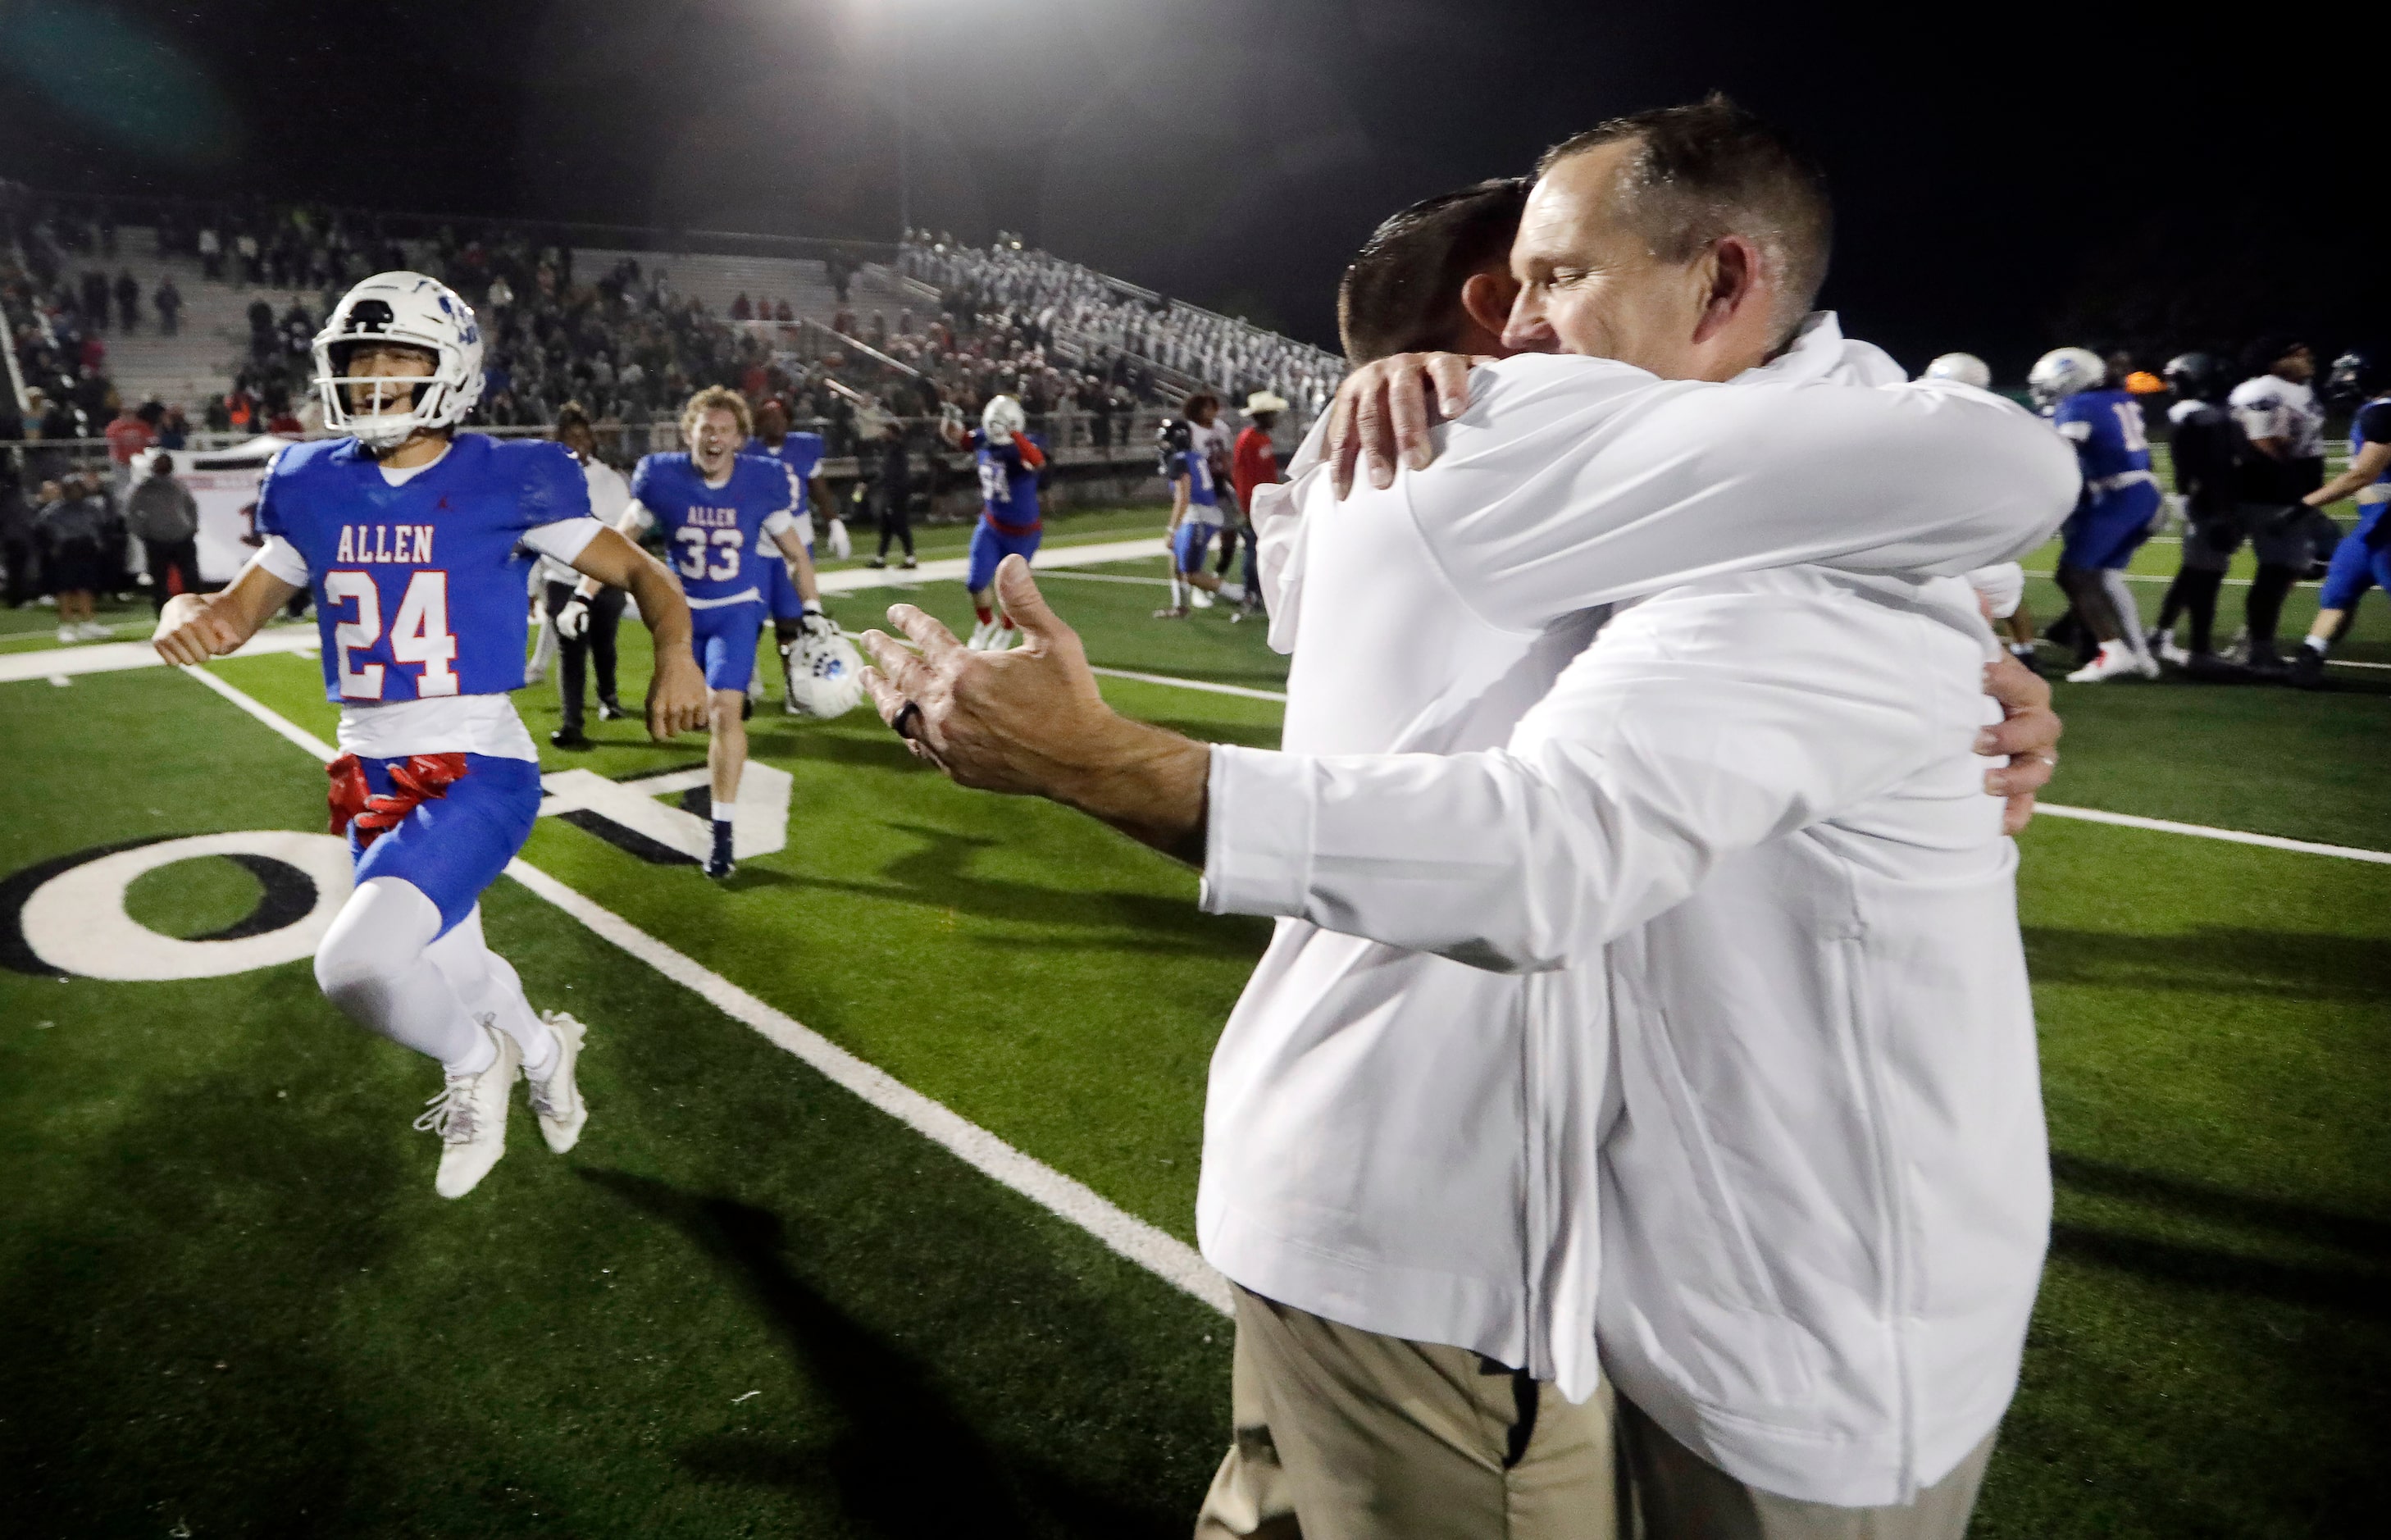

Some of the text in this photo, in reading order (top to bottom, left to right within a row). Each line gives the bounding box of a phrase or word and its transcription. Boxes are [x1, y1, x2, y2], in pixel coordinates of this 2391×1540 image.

[687, 505, 737, 528] ALLEN
[336, 524, 435, 563] ALLEN
[674, 526, 745, 582] 33
[323, 569, 462, 701] 24
